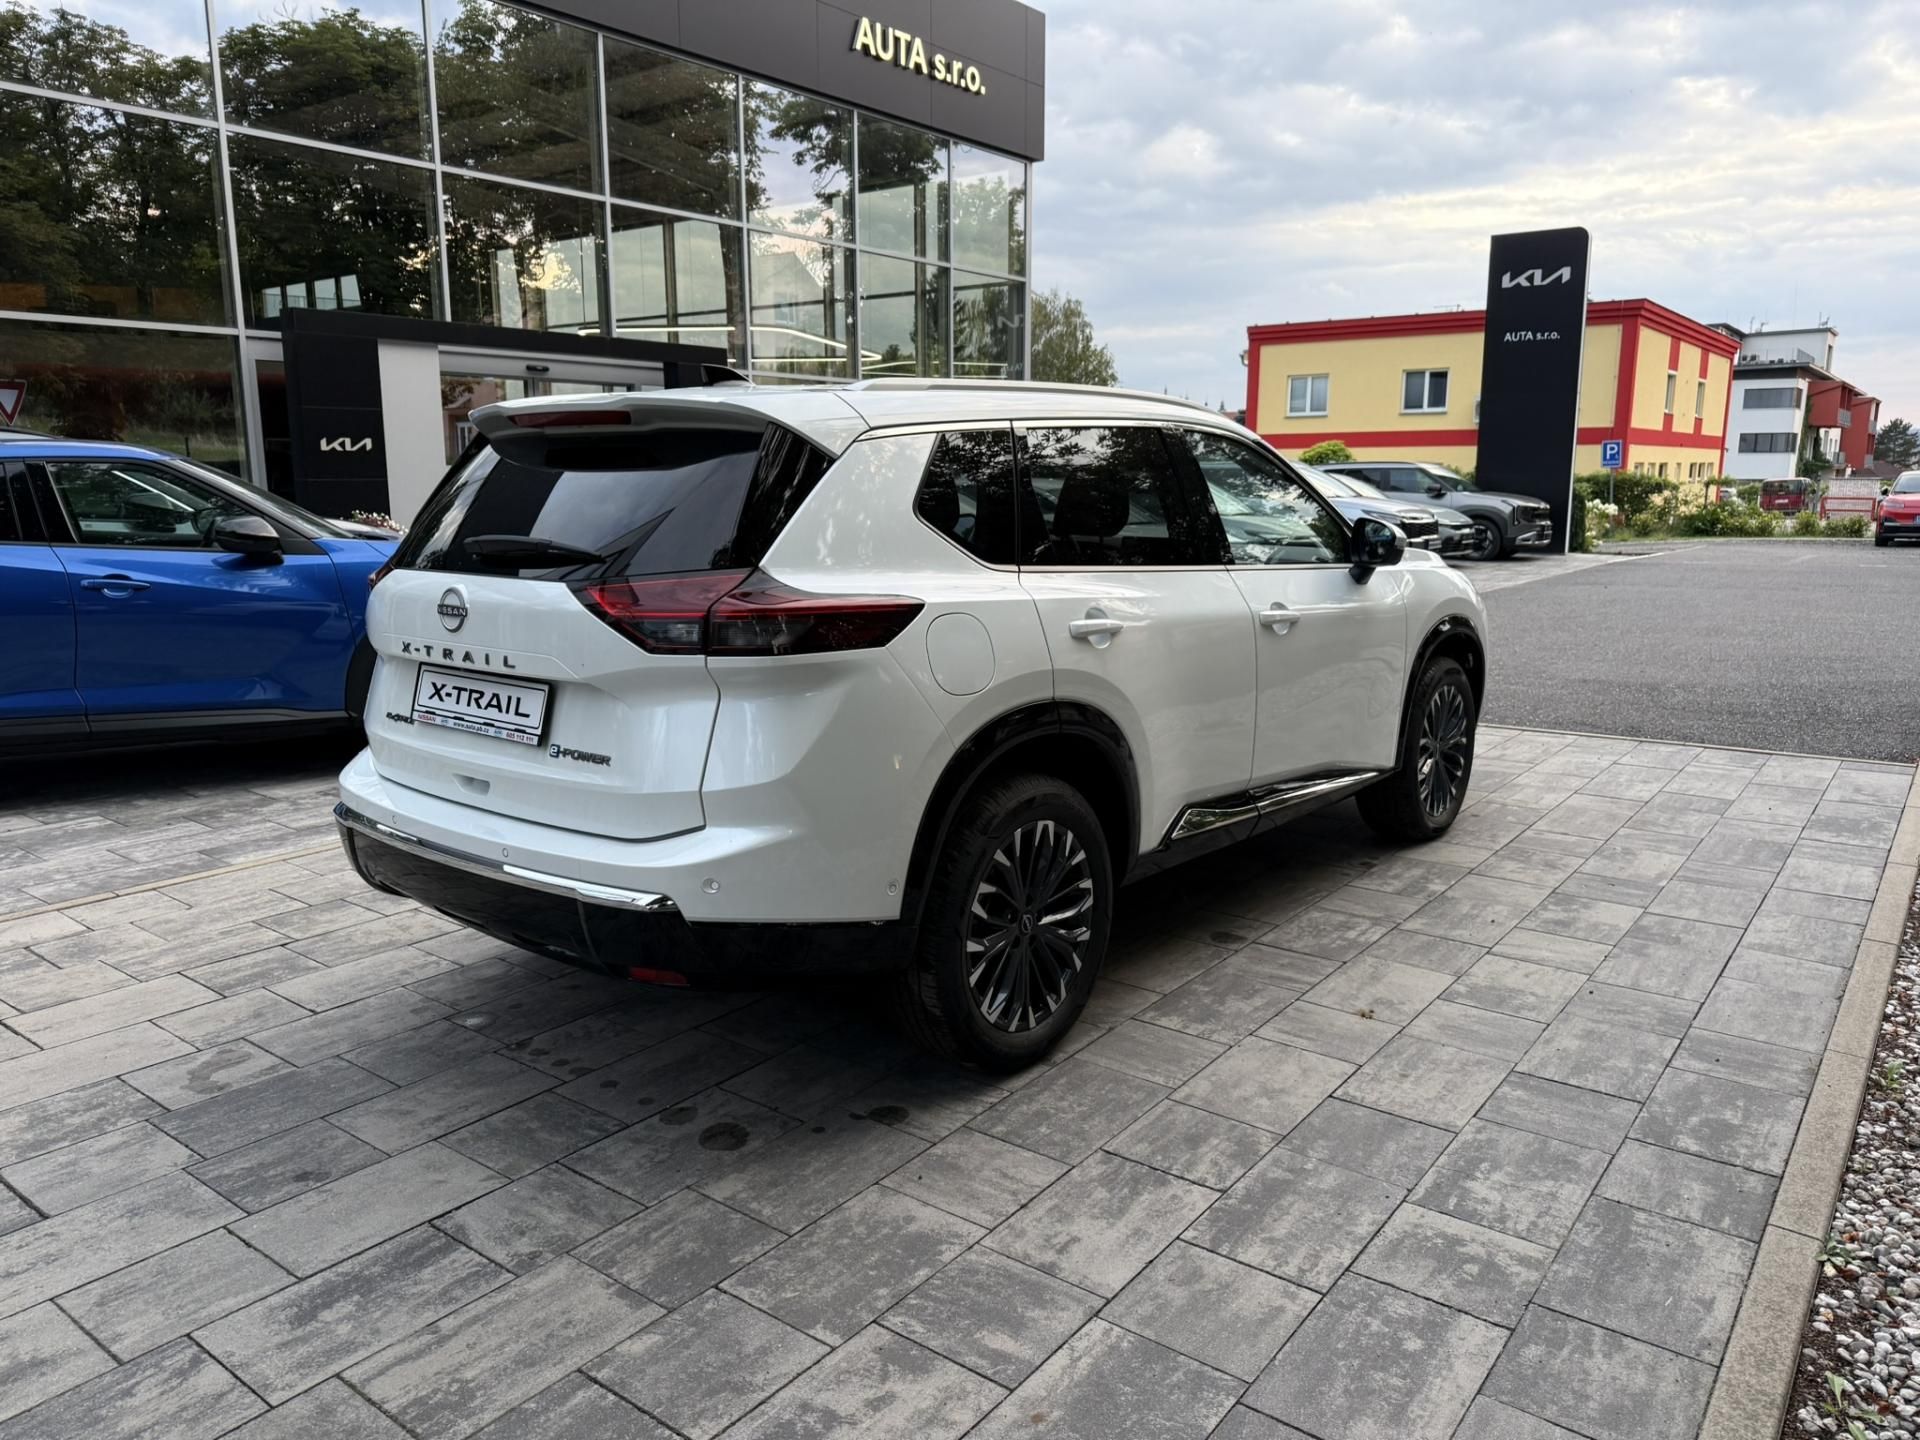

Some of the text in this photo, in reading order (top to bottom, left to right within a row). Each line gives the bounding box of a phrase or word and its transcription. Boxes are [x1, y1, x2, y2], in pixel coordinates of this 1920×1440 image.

[852, 16, 986, 96] AUTA s.r.o.
[1504, 331, 1560, 342] AUTA s.r.o.
[1606, 443, 1618, 460] P
[401, 640, 516, 669] X-TRAIL
[428, 681, 531, 719] X-TRAIL
